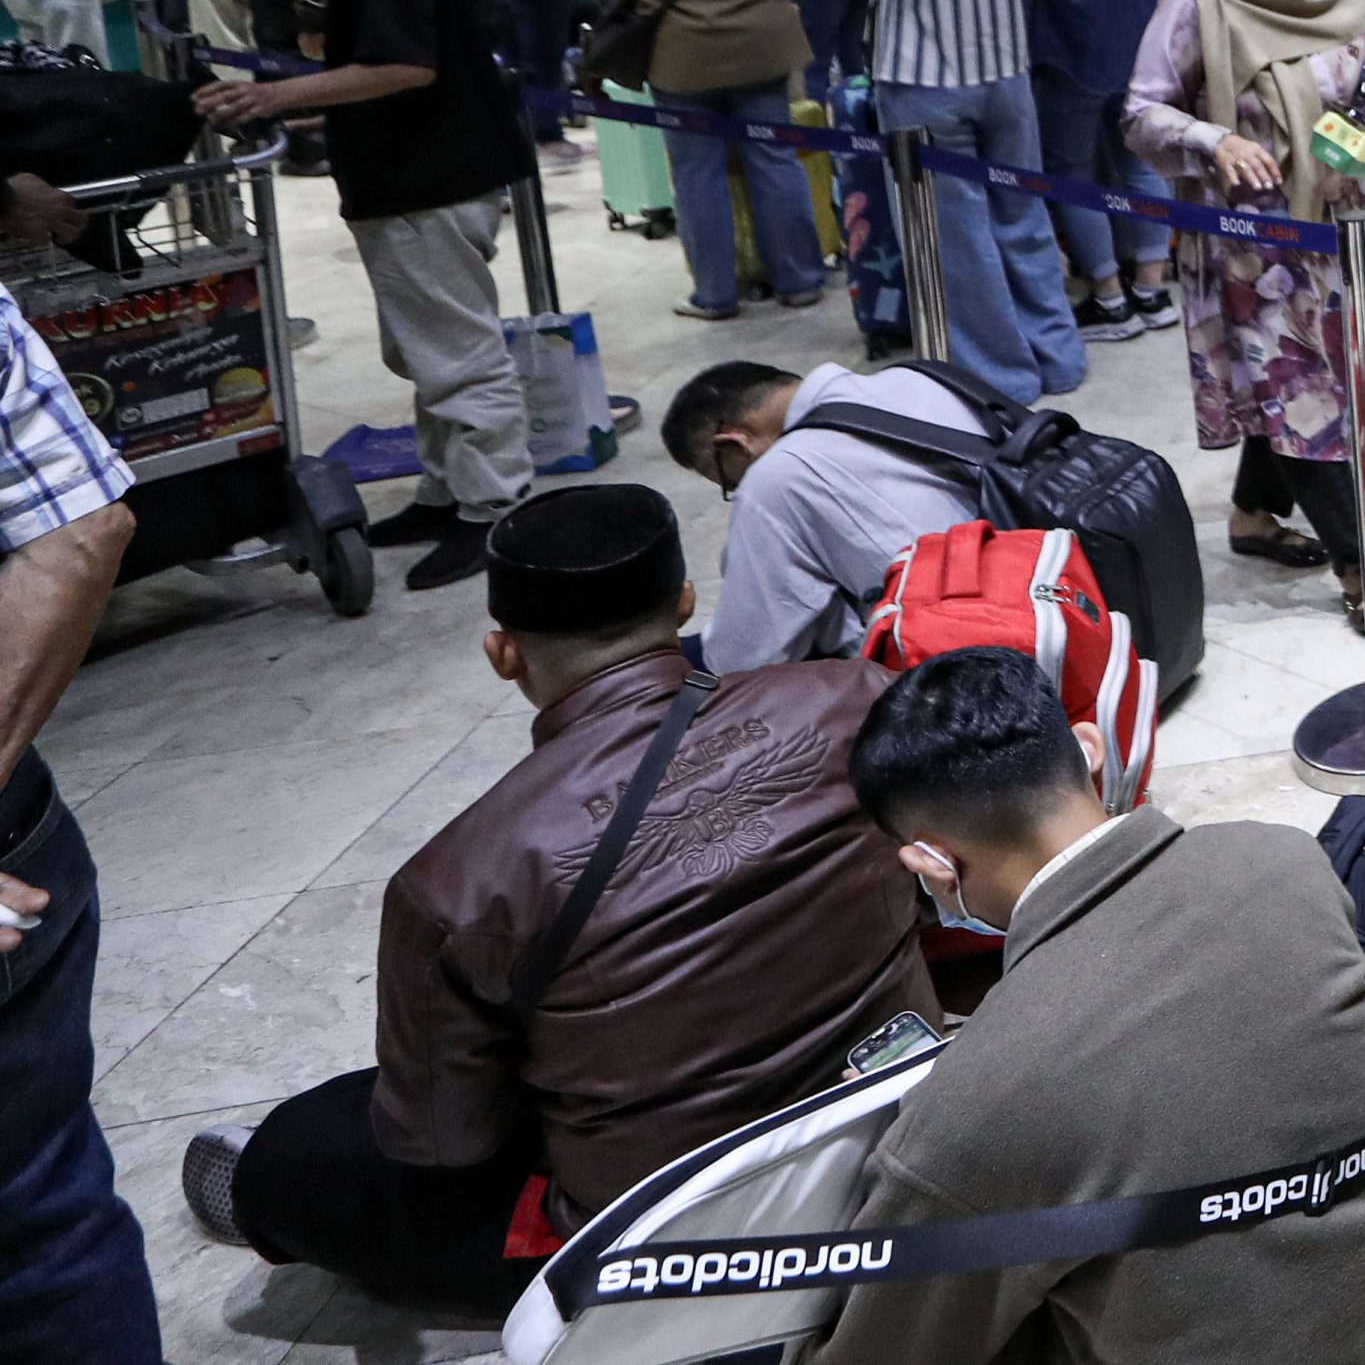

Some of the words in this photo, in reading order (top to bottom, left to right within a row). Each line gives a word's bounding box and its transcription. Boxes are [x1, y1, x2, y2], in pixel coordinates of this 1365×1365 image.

[1220, 215, 1300, 243] BOOKCABIN
[582, 717, 771, 824] BKERS
[597, 1239, 893, 1293] nordicdots
